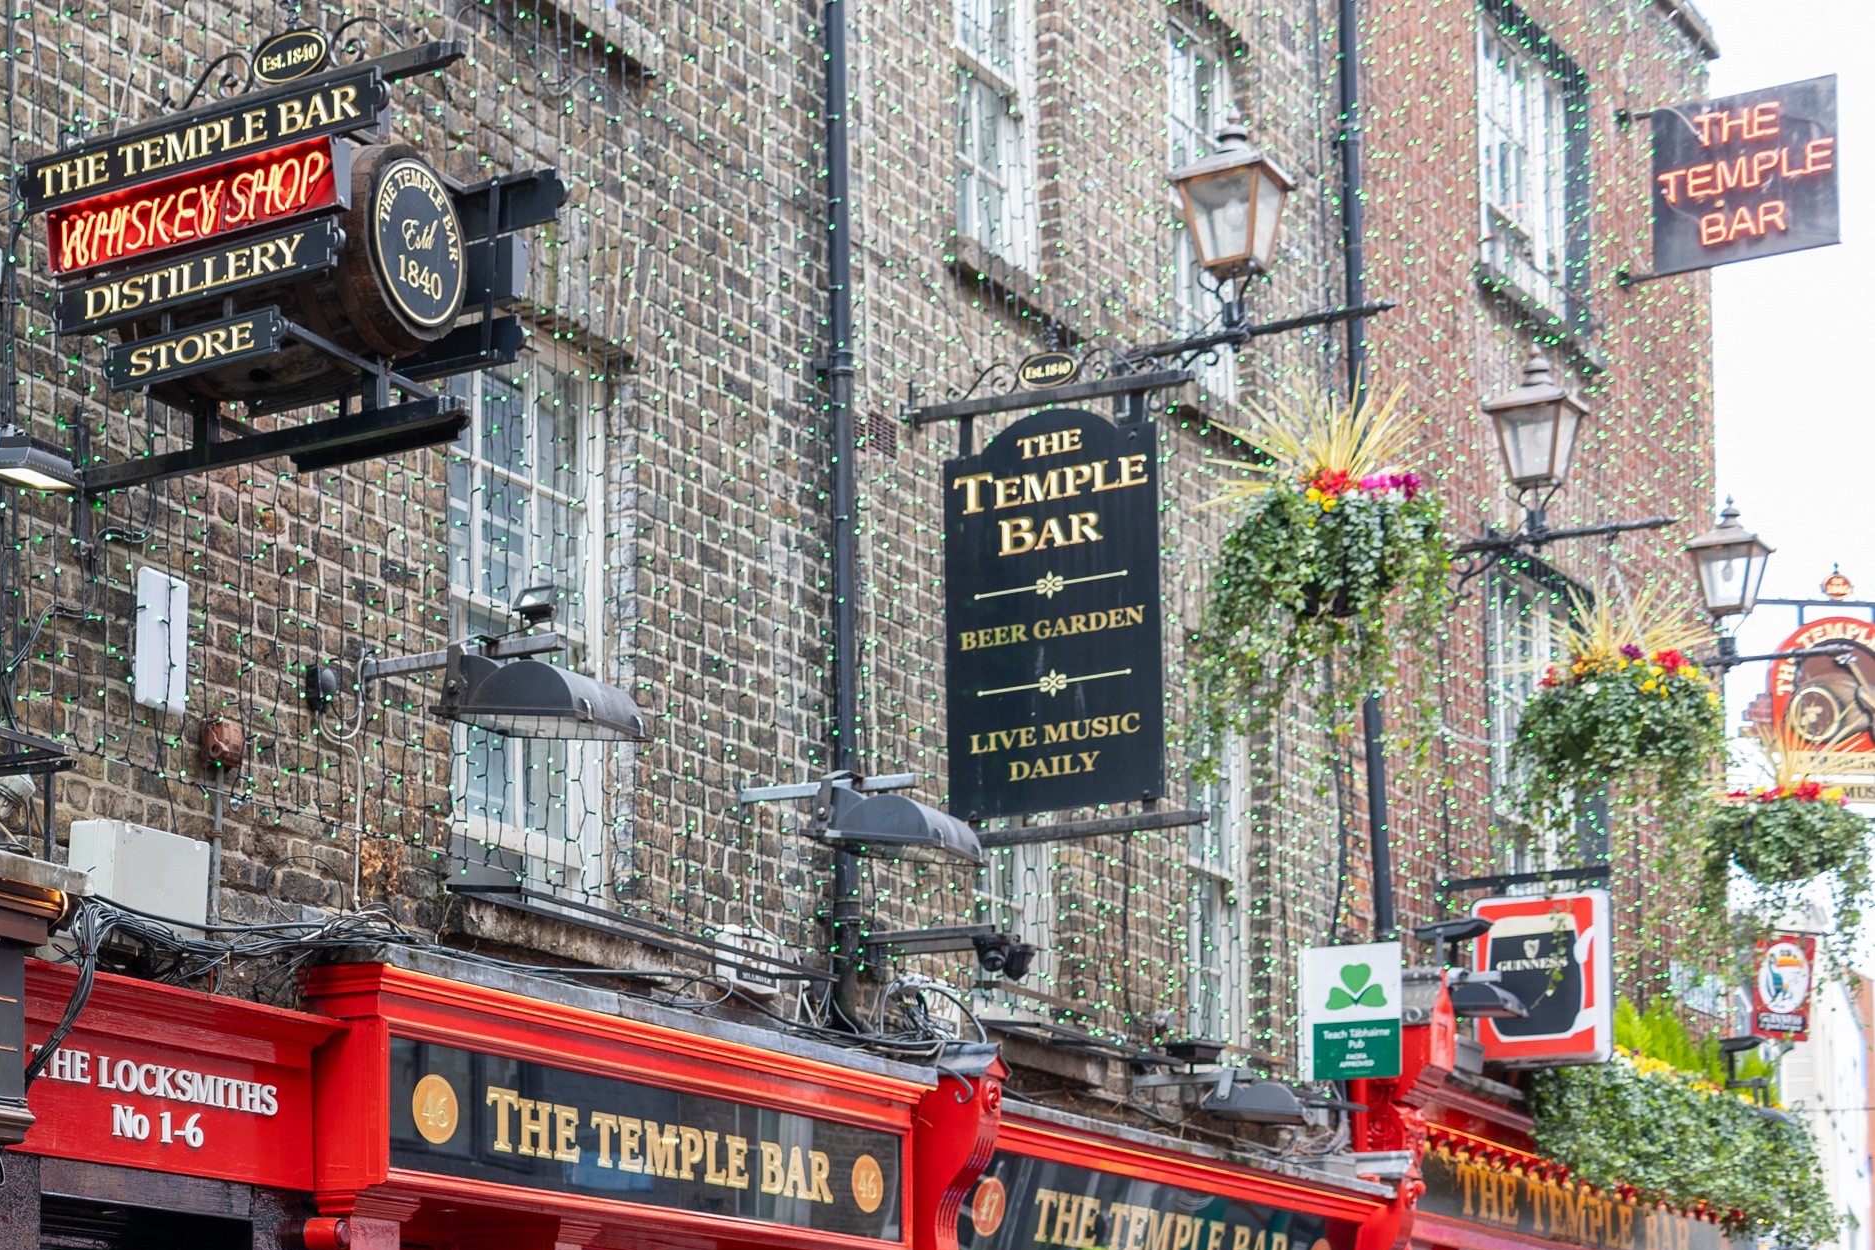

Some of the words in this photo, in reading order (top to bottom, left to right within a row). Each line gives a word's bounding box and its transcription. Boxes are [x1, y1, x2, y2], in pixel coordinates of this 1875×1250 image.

[37, 151, 110, 200] THE
[117, 108, 268, 178] TEMPLE
[277, 84, 361, 138] BAR
[1693, 101, 1781, 147] THE
[1658, 137, 1835, 204] TEMPLE
[61, 179, 224, 271] WHISKEY
[225, 151, 324, 224] SHOP
[380, 181, 398, 223] THE
[394, 168, 445, 212] TEMPLE
[442, 213, 459, 262] BAR
[1700, 198, 1788, 247] BAR
[84, 232, 304, 320] DISTILLERY
[398, 254, 443, 301] 1840
[129, 320, 256, 377] STORE
[1017, 427, 1083, 461] THE
[953, 453, 1149, 516] TEMPLE
[997, 510, 1104, 558] BAR
[959, 624, 1029, 652] BEER
[1033, 604, 1146, 642] GARDEN
[969, 726, 1038, 756] LIVE
[1043, 712, 1141, 744] MUSIC
[1008, 750, 1101, 783] DAILY
[1348, 1038, 1365, 1049] Pub
[97, 1055, 279, 1117] LOCKSMITHS
[111, 1103, 151, 1142] No
[159, 1111, 205, 1149] 1-6
[420, 1090, 450, 1129] 46
[486, 1085, 581, 1164] THE
[590, 1110, 750, 1191] TEMPLE
[760, 1140, 835, 1206] BAR
[856, 1167, 879, 1200] 46
[979, 1192, 1000, 1223] 47
[1034, 1188, 1101, 1248] THE
[1458, 1162, 1519, 1226] THE
[1527, 1180, 1635, 1250] TEMPLE
